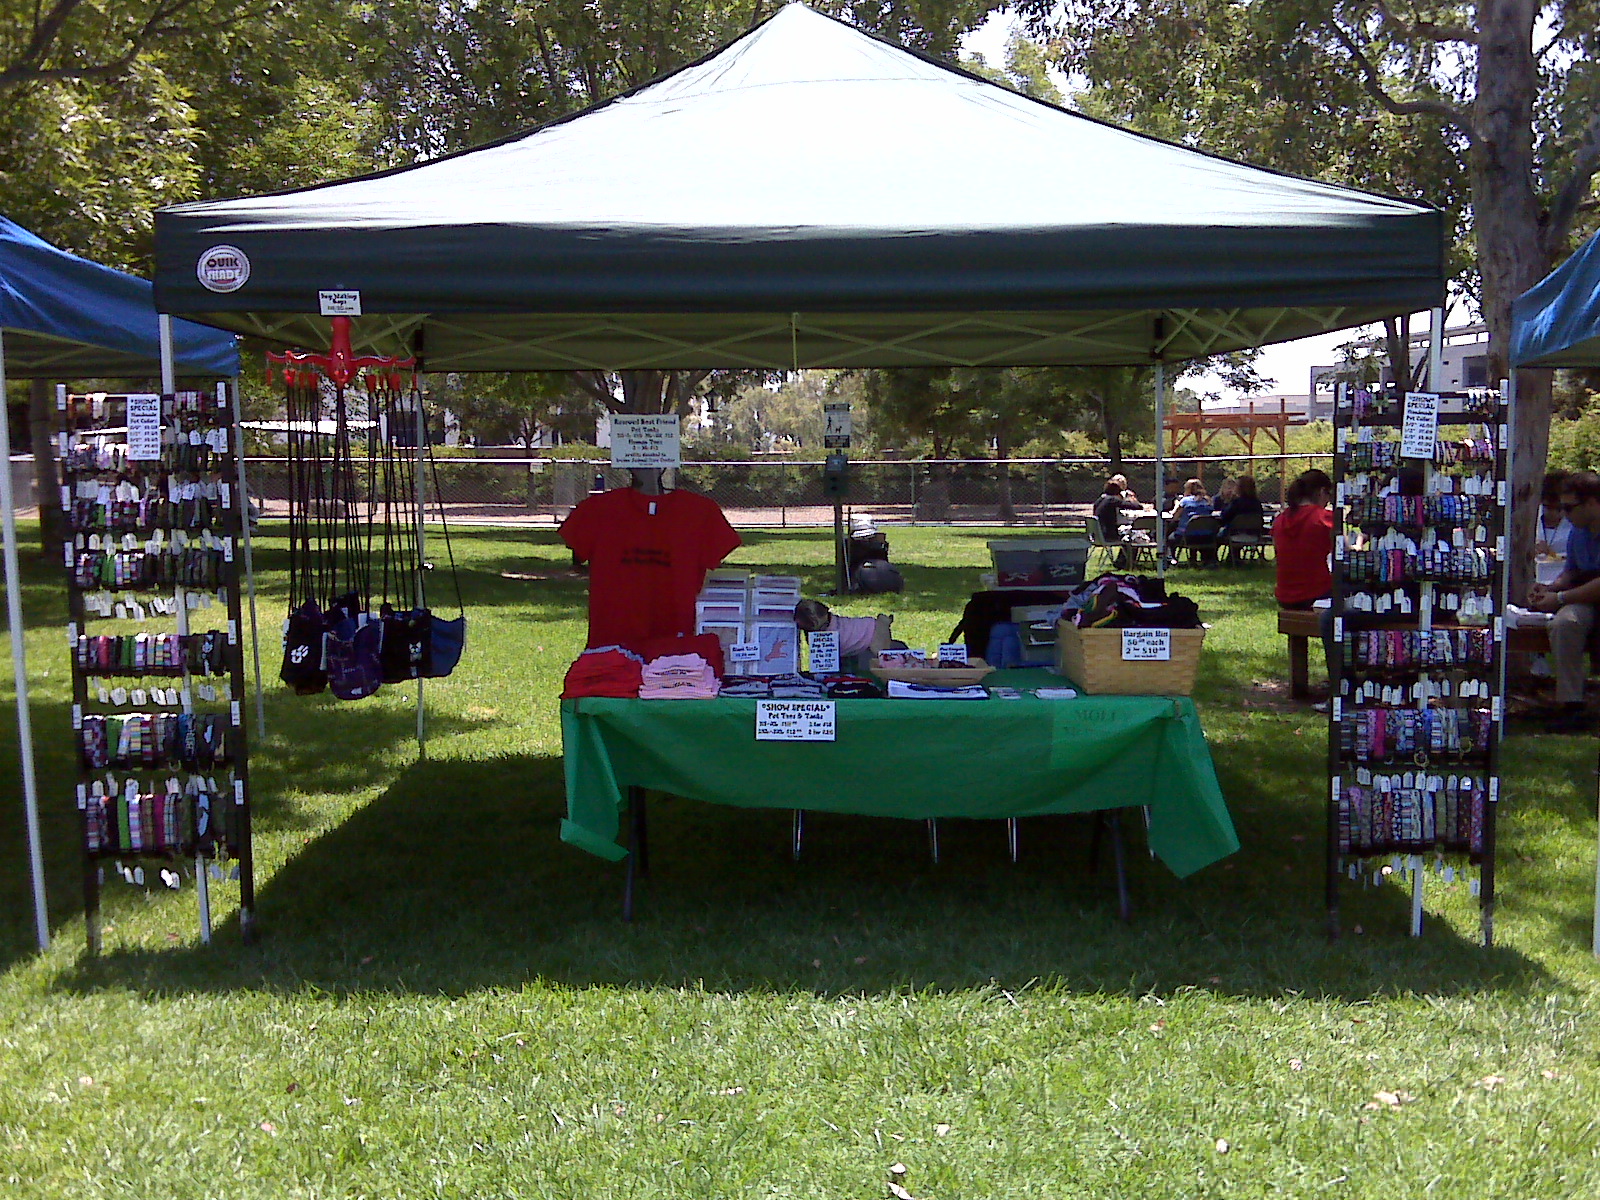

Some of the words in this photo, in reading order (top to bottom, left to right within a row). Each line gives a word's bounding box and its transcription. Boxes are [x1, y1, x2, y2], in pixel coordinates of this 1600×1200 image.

[206, 257, 239, 268] QUIK
[207, 269, 241, 280] SHADE
[1123, 630, 1153, 638] Bargain
